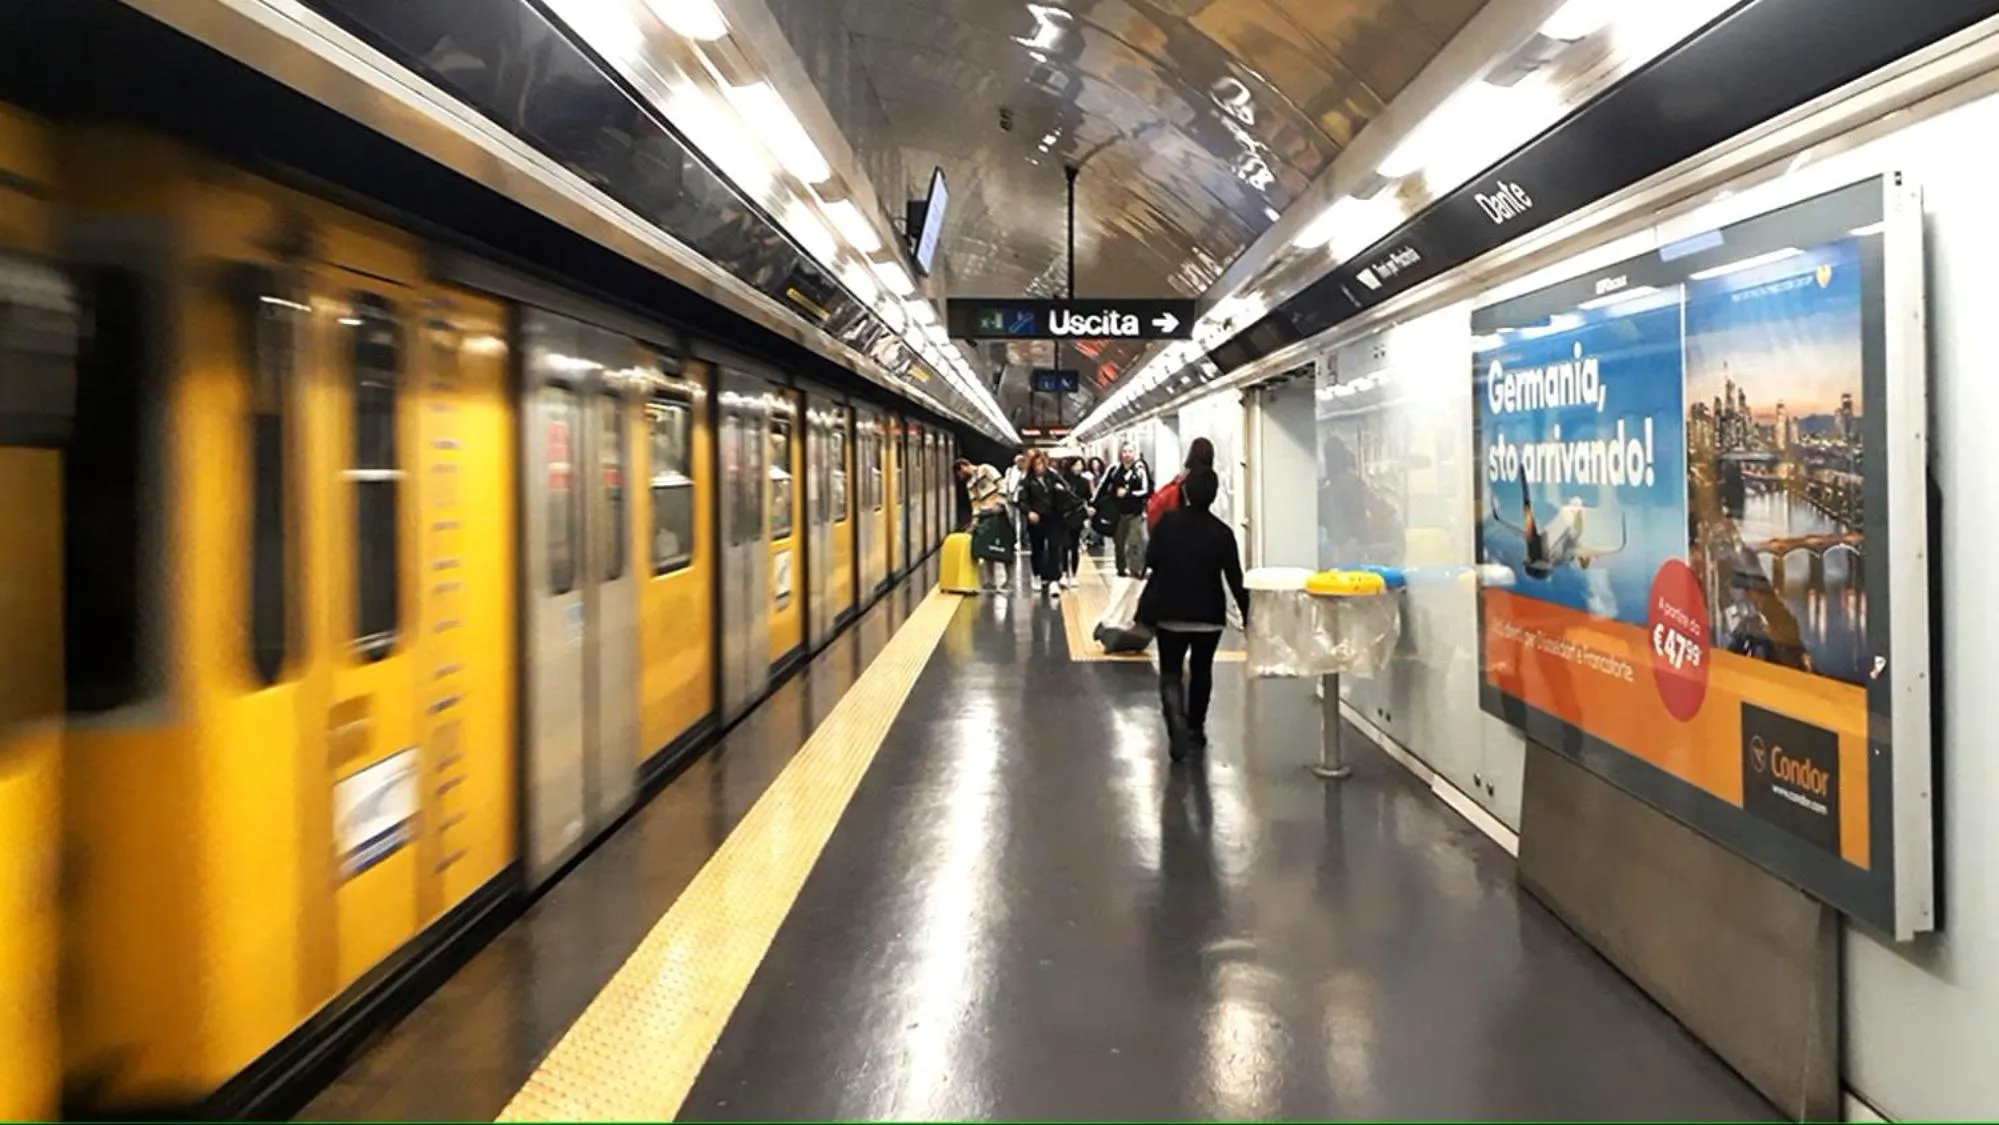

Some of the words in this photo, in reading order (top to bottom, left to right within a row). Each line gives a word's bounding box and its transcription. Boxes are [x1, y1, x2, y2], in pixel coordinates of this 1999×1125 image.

[1473, 180, 1533, 225] Dante
[1048, 309, 1140, 336] Uscita
[1488, 341, 1607, 414] Germania,
[1489, 433, 1519, 482] sto
[1521, 416, 1655, 488] arrivando!
[1771, 745, 1830, 797] Condor
